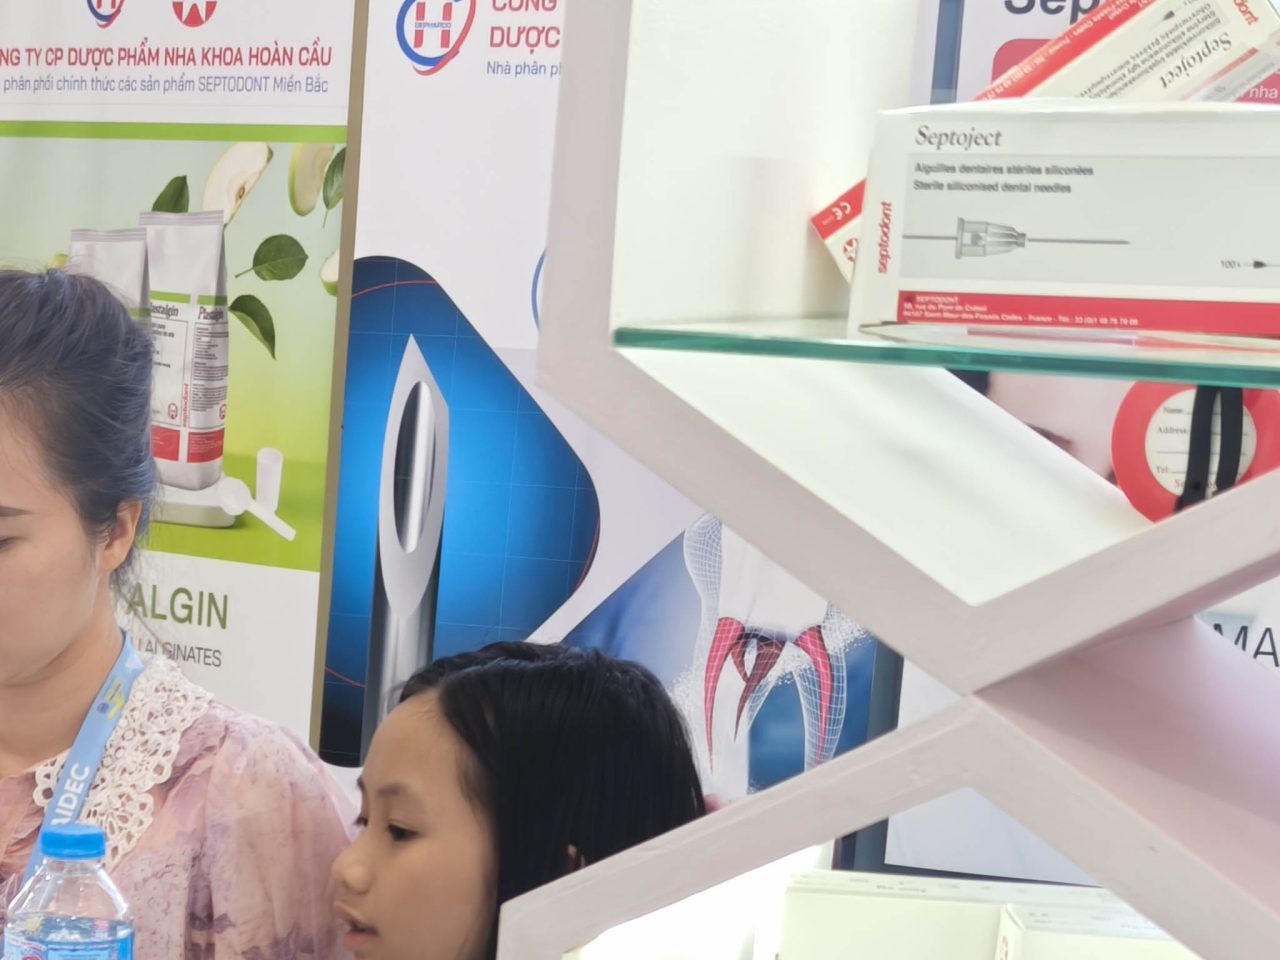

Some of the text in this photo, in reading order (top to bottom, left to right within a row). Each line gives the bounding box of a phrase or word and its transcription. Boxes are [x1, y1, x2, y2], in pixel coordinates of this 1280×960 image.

[25, 47, 42, 67] TY
[45, 47, 63, 67] CP
[68, 47, 113, 71] DƯỢC
[118, 36, 160, 67] PHẨM
[164, 46, 196, 67] NHA
[201, 46, 244, 67] KHOA
[248, 40, 293, 67] HOÀN
[298, 36, 332, 67] CẦU
[489, 26, 561, 54] DƯỢC
[487, 61, 511, 75] Nhà
[515, 61, 546, 77] phân
[1154, 27, 1235, 93] Septoject
[4, 75, 30, 93] phân
[56, 75, 86, 92] chính
[118, 75, 136, 92] các
[140, 74, 160, 92] sản
[198, 75, 270, 93] SEPTODONT
[305, 73, 328, 93] Bắc
[916, 125, 1002, 150] Septoject
[915, 163, 1094, 177] Aiguilles dentaires stériles siliconées
[913, 181, 1071, 194] Sterile siliconised dental needles
[878, 201, 892, 274] septodont
[125, 582, 228, 630] ALGIN
[51, 762, 90, 828] AIDEC
